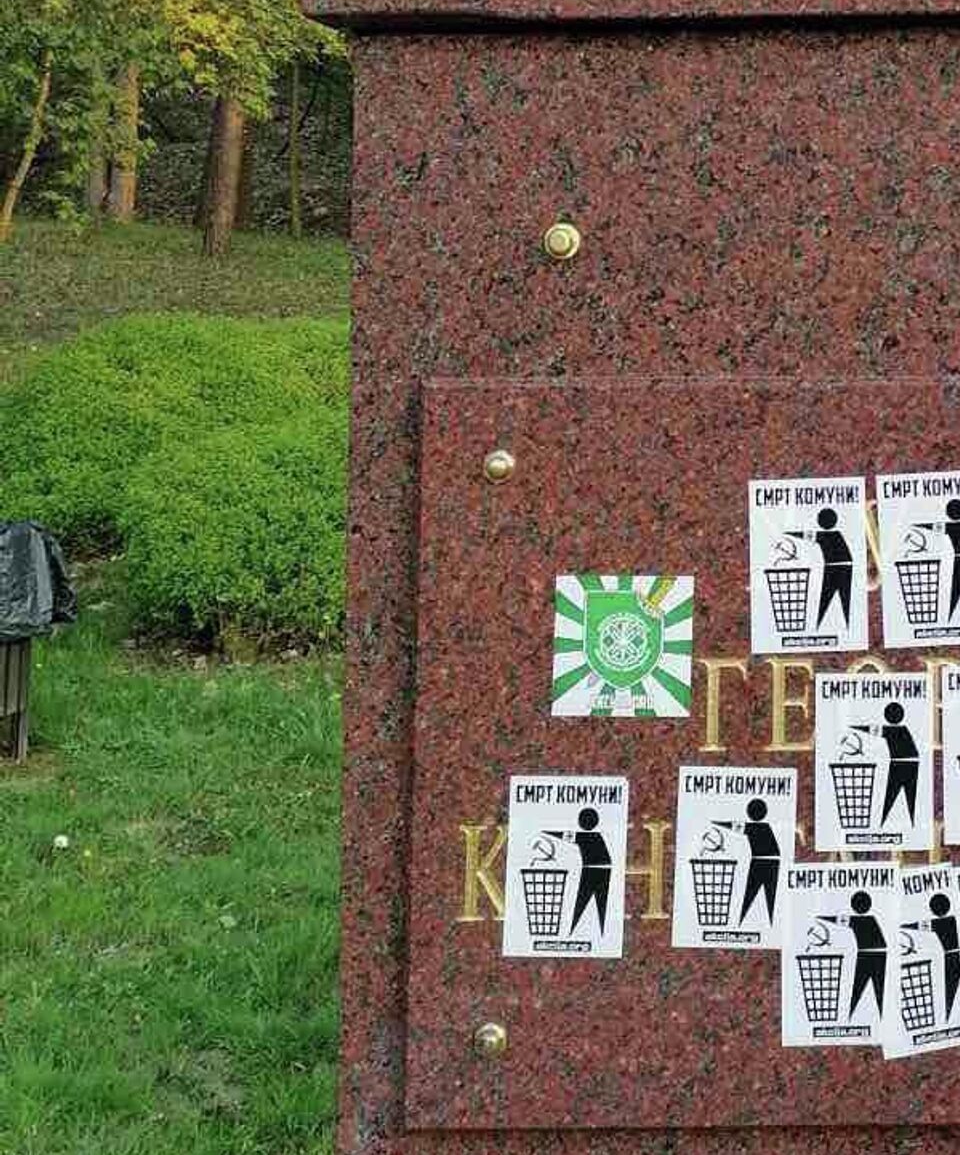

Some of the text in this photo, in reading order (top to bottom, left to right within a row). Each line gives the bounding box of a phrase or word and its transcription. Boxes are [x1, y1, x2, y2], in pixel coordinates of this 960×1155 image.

[756, 485, 860, 506] СМРТ КОМУНИ!
[883, 480, 919, 499] СМРТ
[822, 679, 927, 699] СМРТ КОМУНИ!
[516, 785, 622, 804] СМРТ КОМУНИ!
[685, 775, 791, 795] СМРТ КОМУНИ!
[788, 868, 894, 889] СМРТ КОМУНИ!
